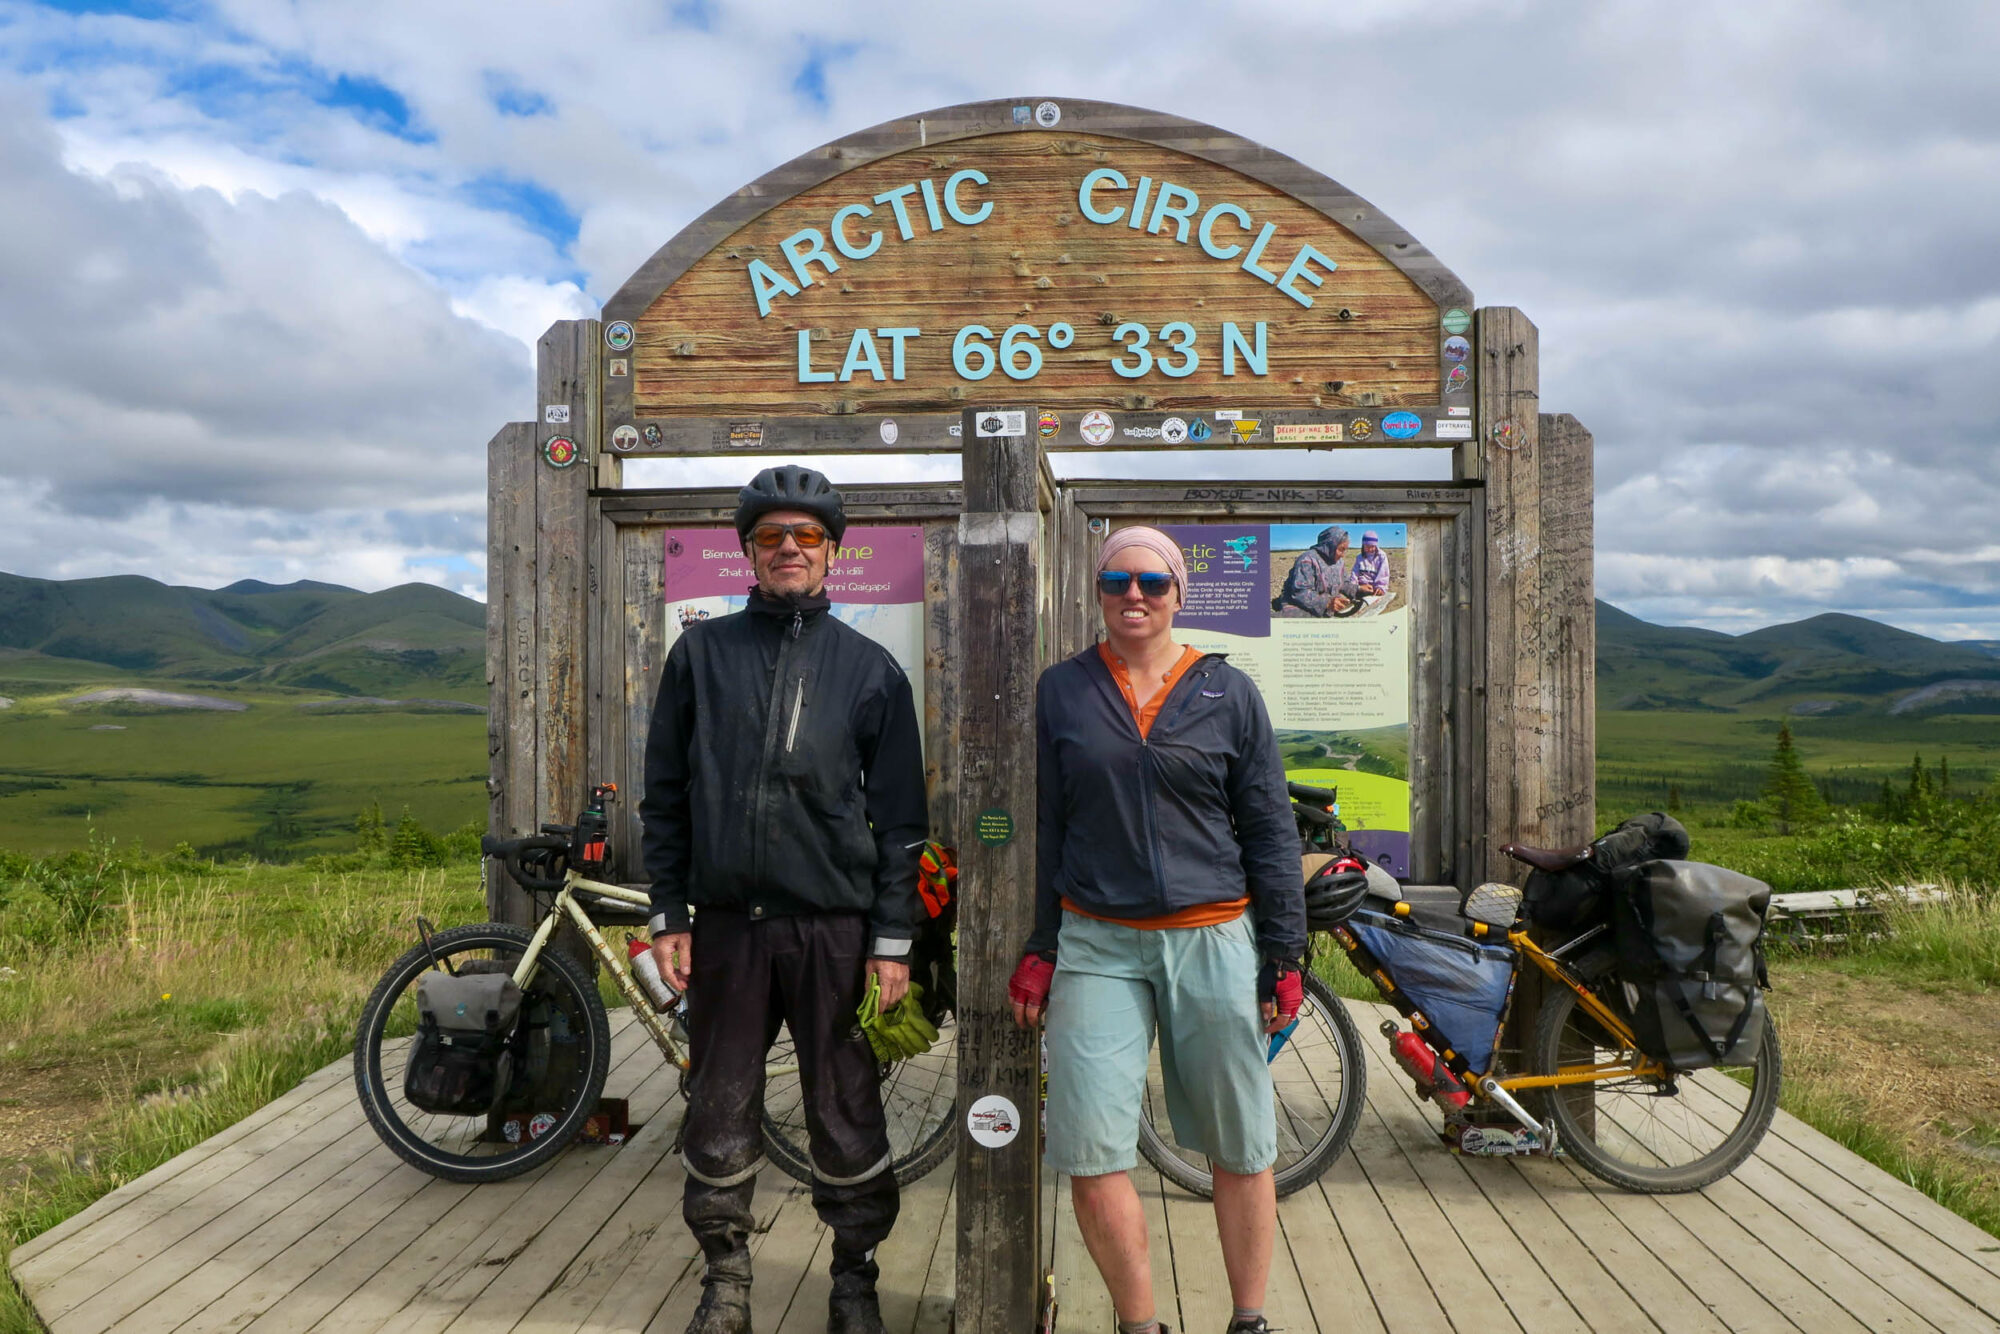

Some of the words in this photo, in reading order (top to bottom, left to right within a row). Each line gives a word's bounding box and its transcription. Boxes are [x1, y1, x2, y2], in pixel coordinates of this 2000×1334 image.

[747, 168, 995, 318] ARCTIC
[1078, 167, 1340, 309] CIRCLE
[797, 327, 921, 384] LAT
[1110, 321, 1200, 379] 33
[1222, 321, 1270, 377] N
